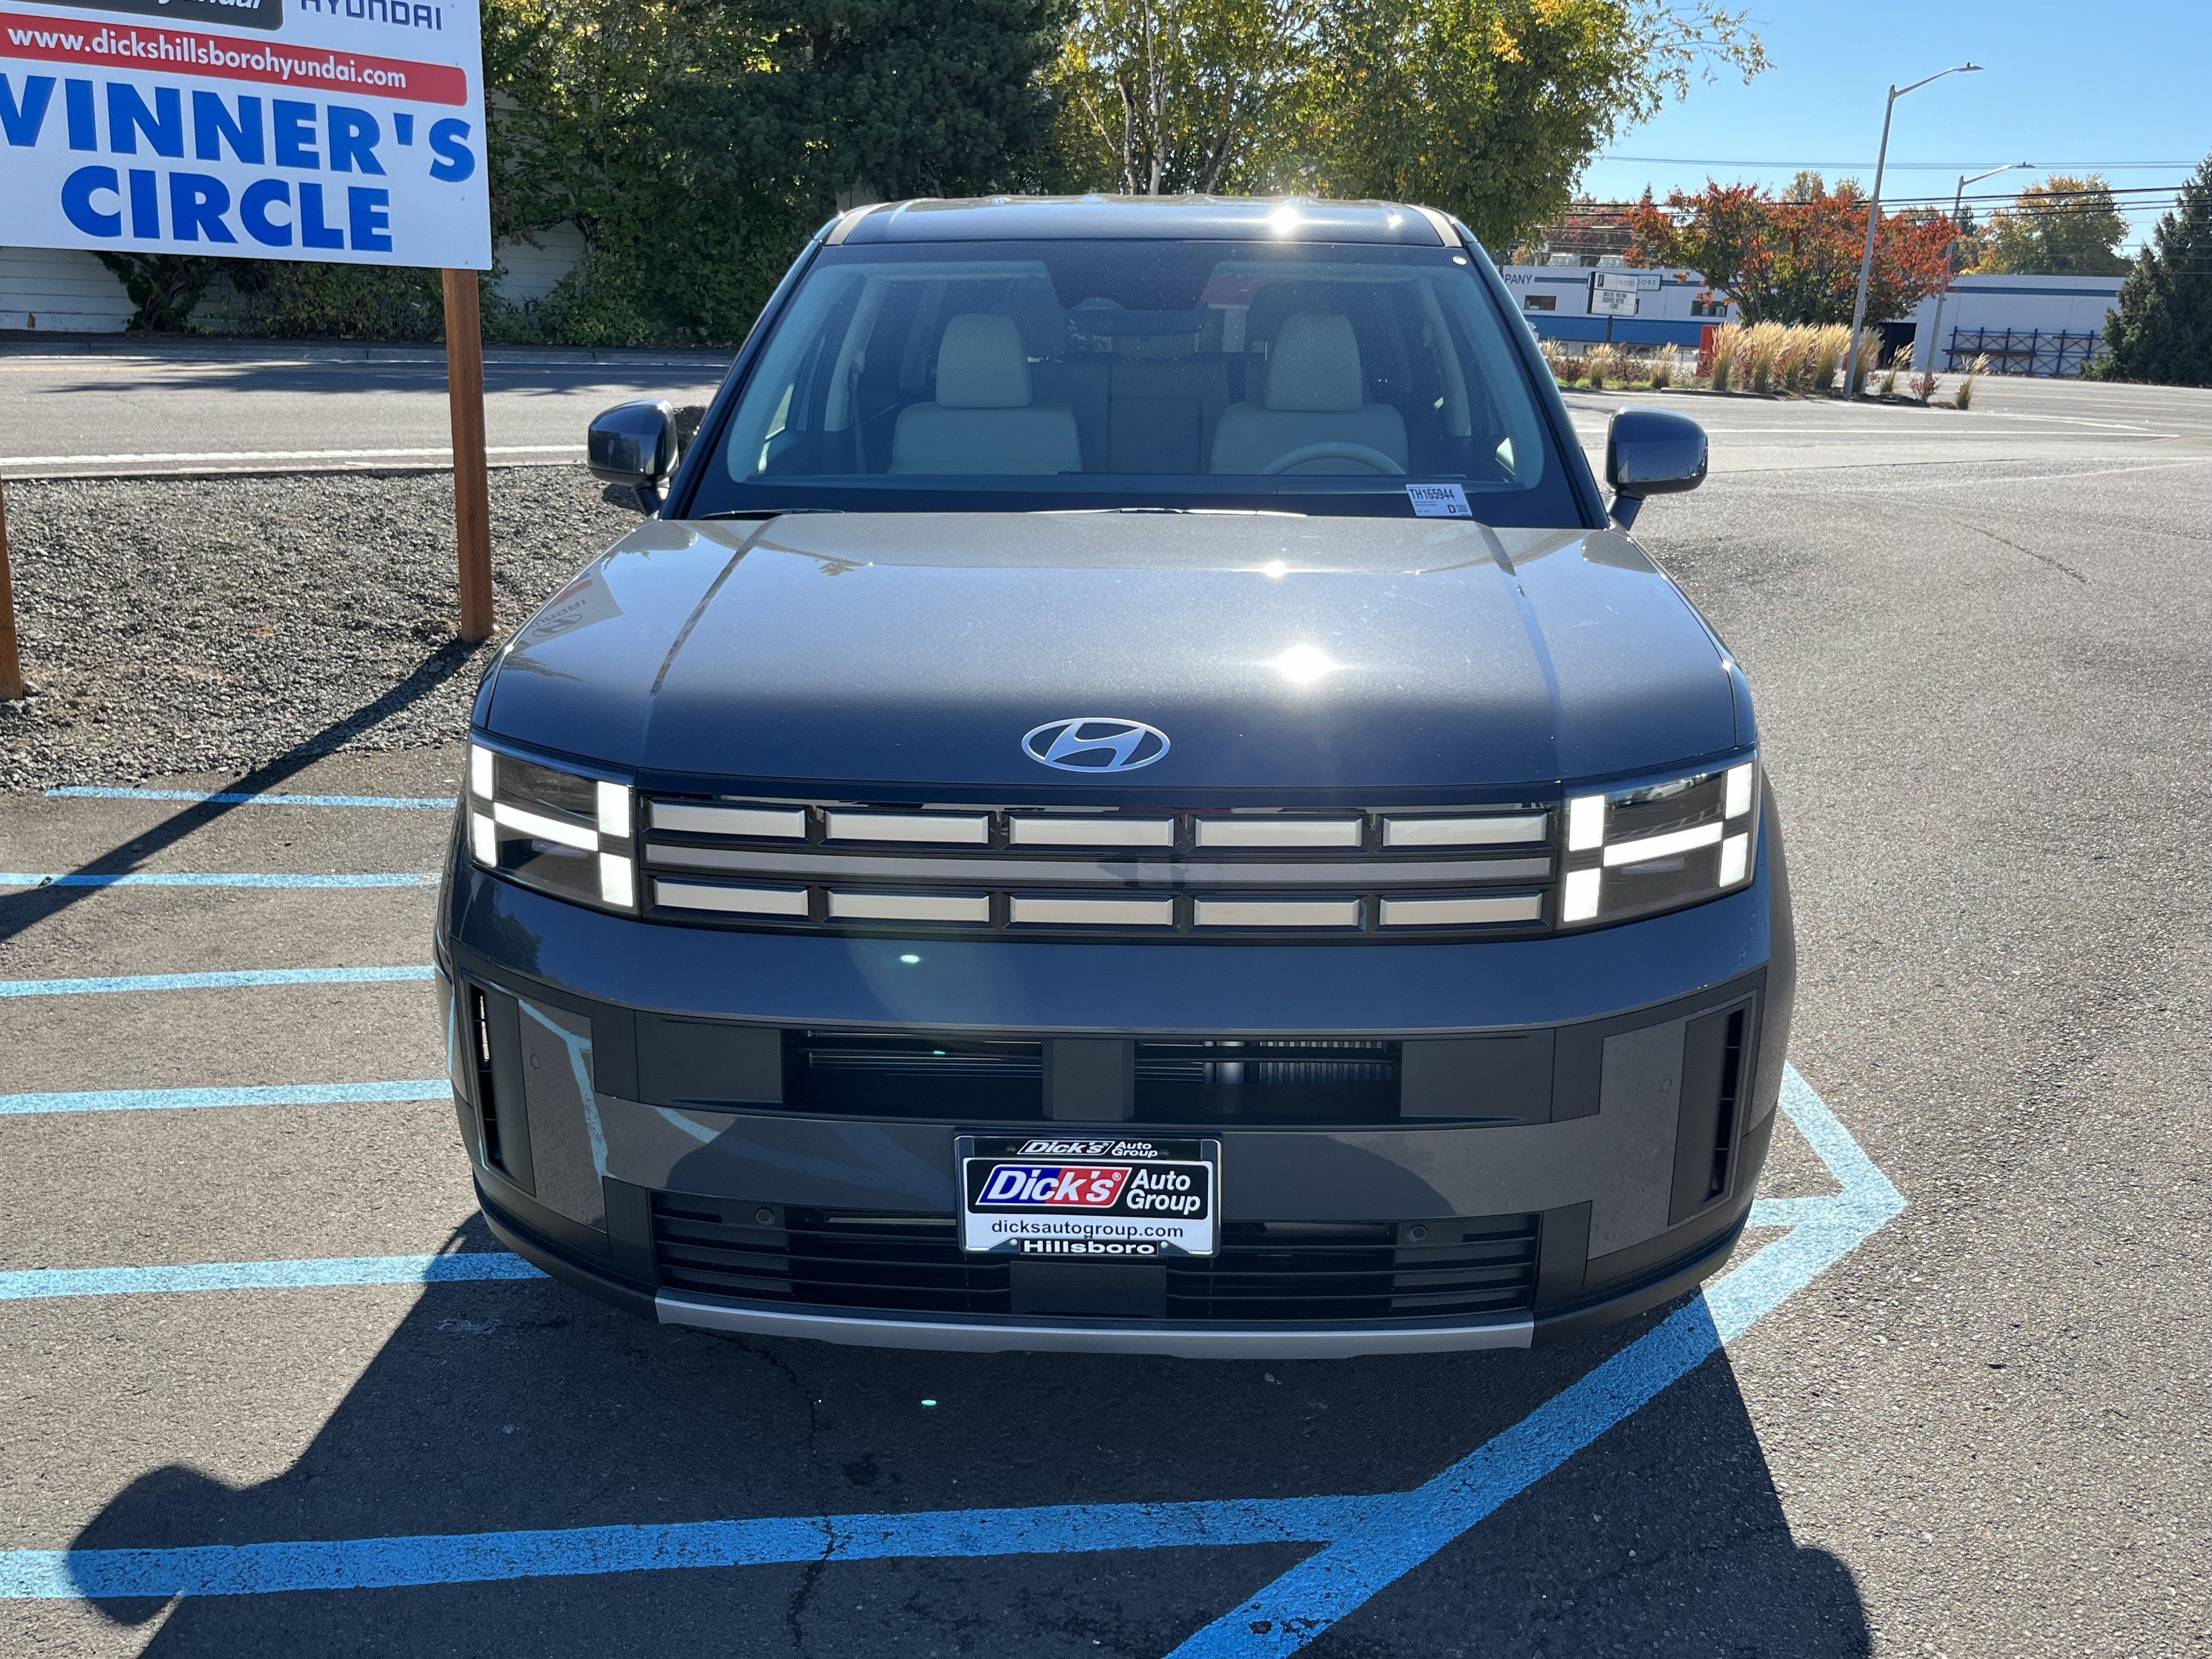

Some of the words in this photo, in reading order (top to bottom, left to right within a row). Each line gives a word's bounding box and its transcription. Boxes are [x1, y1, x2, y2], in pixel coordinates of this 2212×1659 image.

[8, 28, 406, 88] www.dickshillsborohyundai.com
[61, 165, 393, 252] CIRCLE
[1502, 274, 1532, 284] PANY
[1409, 489, 1454, 500] TH165944
[1447, 505, 1456, 514] D
[1111, 1148, 1158, 1158] Group
[1114, 1141, 1152, 1149] Auto
[1131, 1169, 1191, 1190] Auto
[1126, 1189, 1200, 1215] Group
[992, 1220, 1183, 1239] dicksautogroup.com
[1023, 1239, 1155, 1255] Hillsboro
